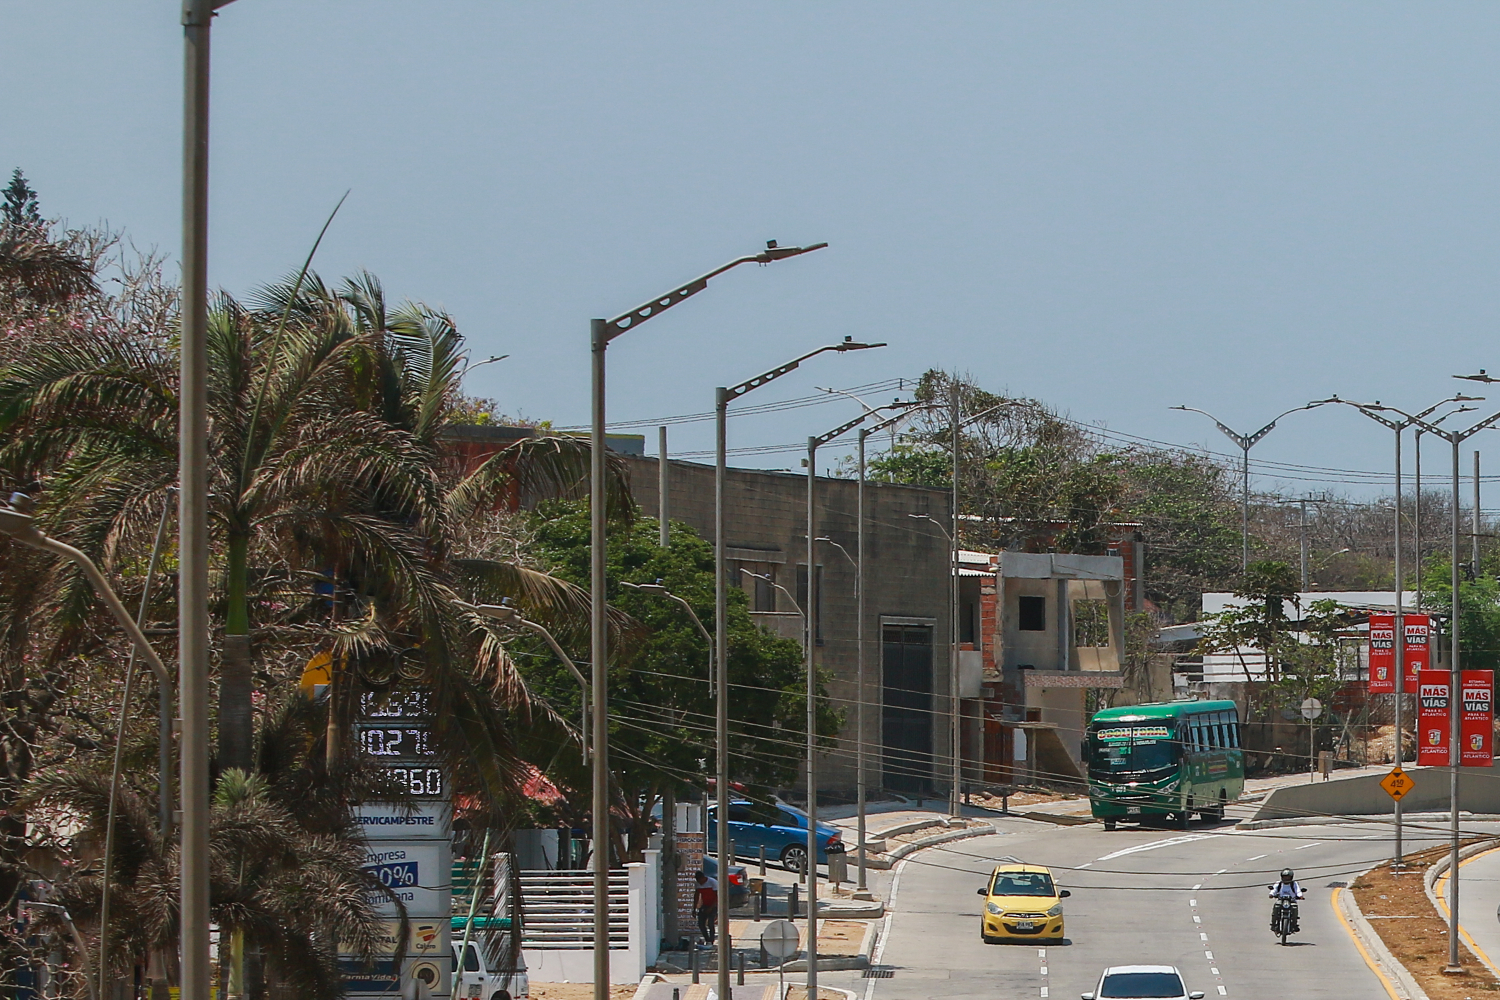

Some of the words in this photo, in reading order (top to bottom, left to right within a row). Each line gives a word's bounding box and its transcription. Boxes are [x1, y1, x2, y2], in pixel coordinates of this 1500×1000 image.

[1423, 687, 1447, 696] MÁS
[1465, 691, 1489, 700] MÁS
[1422, 698, 1447, 707] VÍAS
[1465, 702, 1489, 711] VÍAS
[356, 816, 434, 825] ERVICAMPESTRE
[366, 850, 406, 864] mpresa
